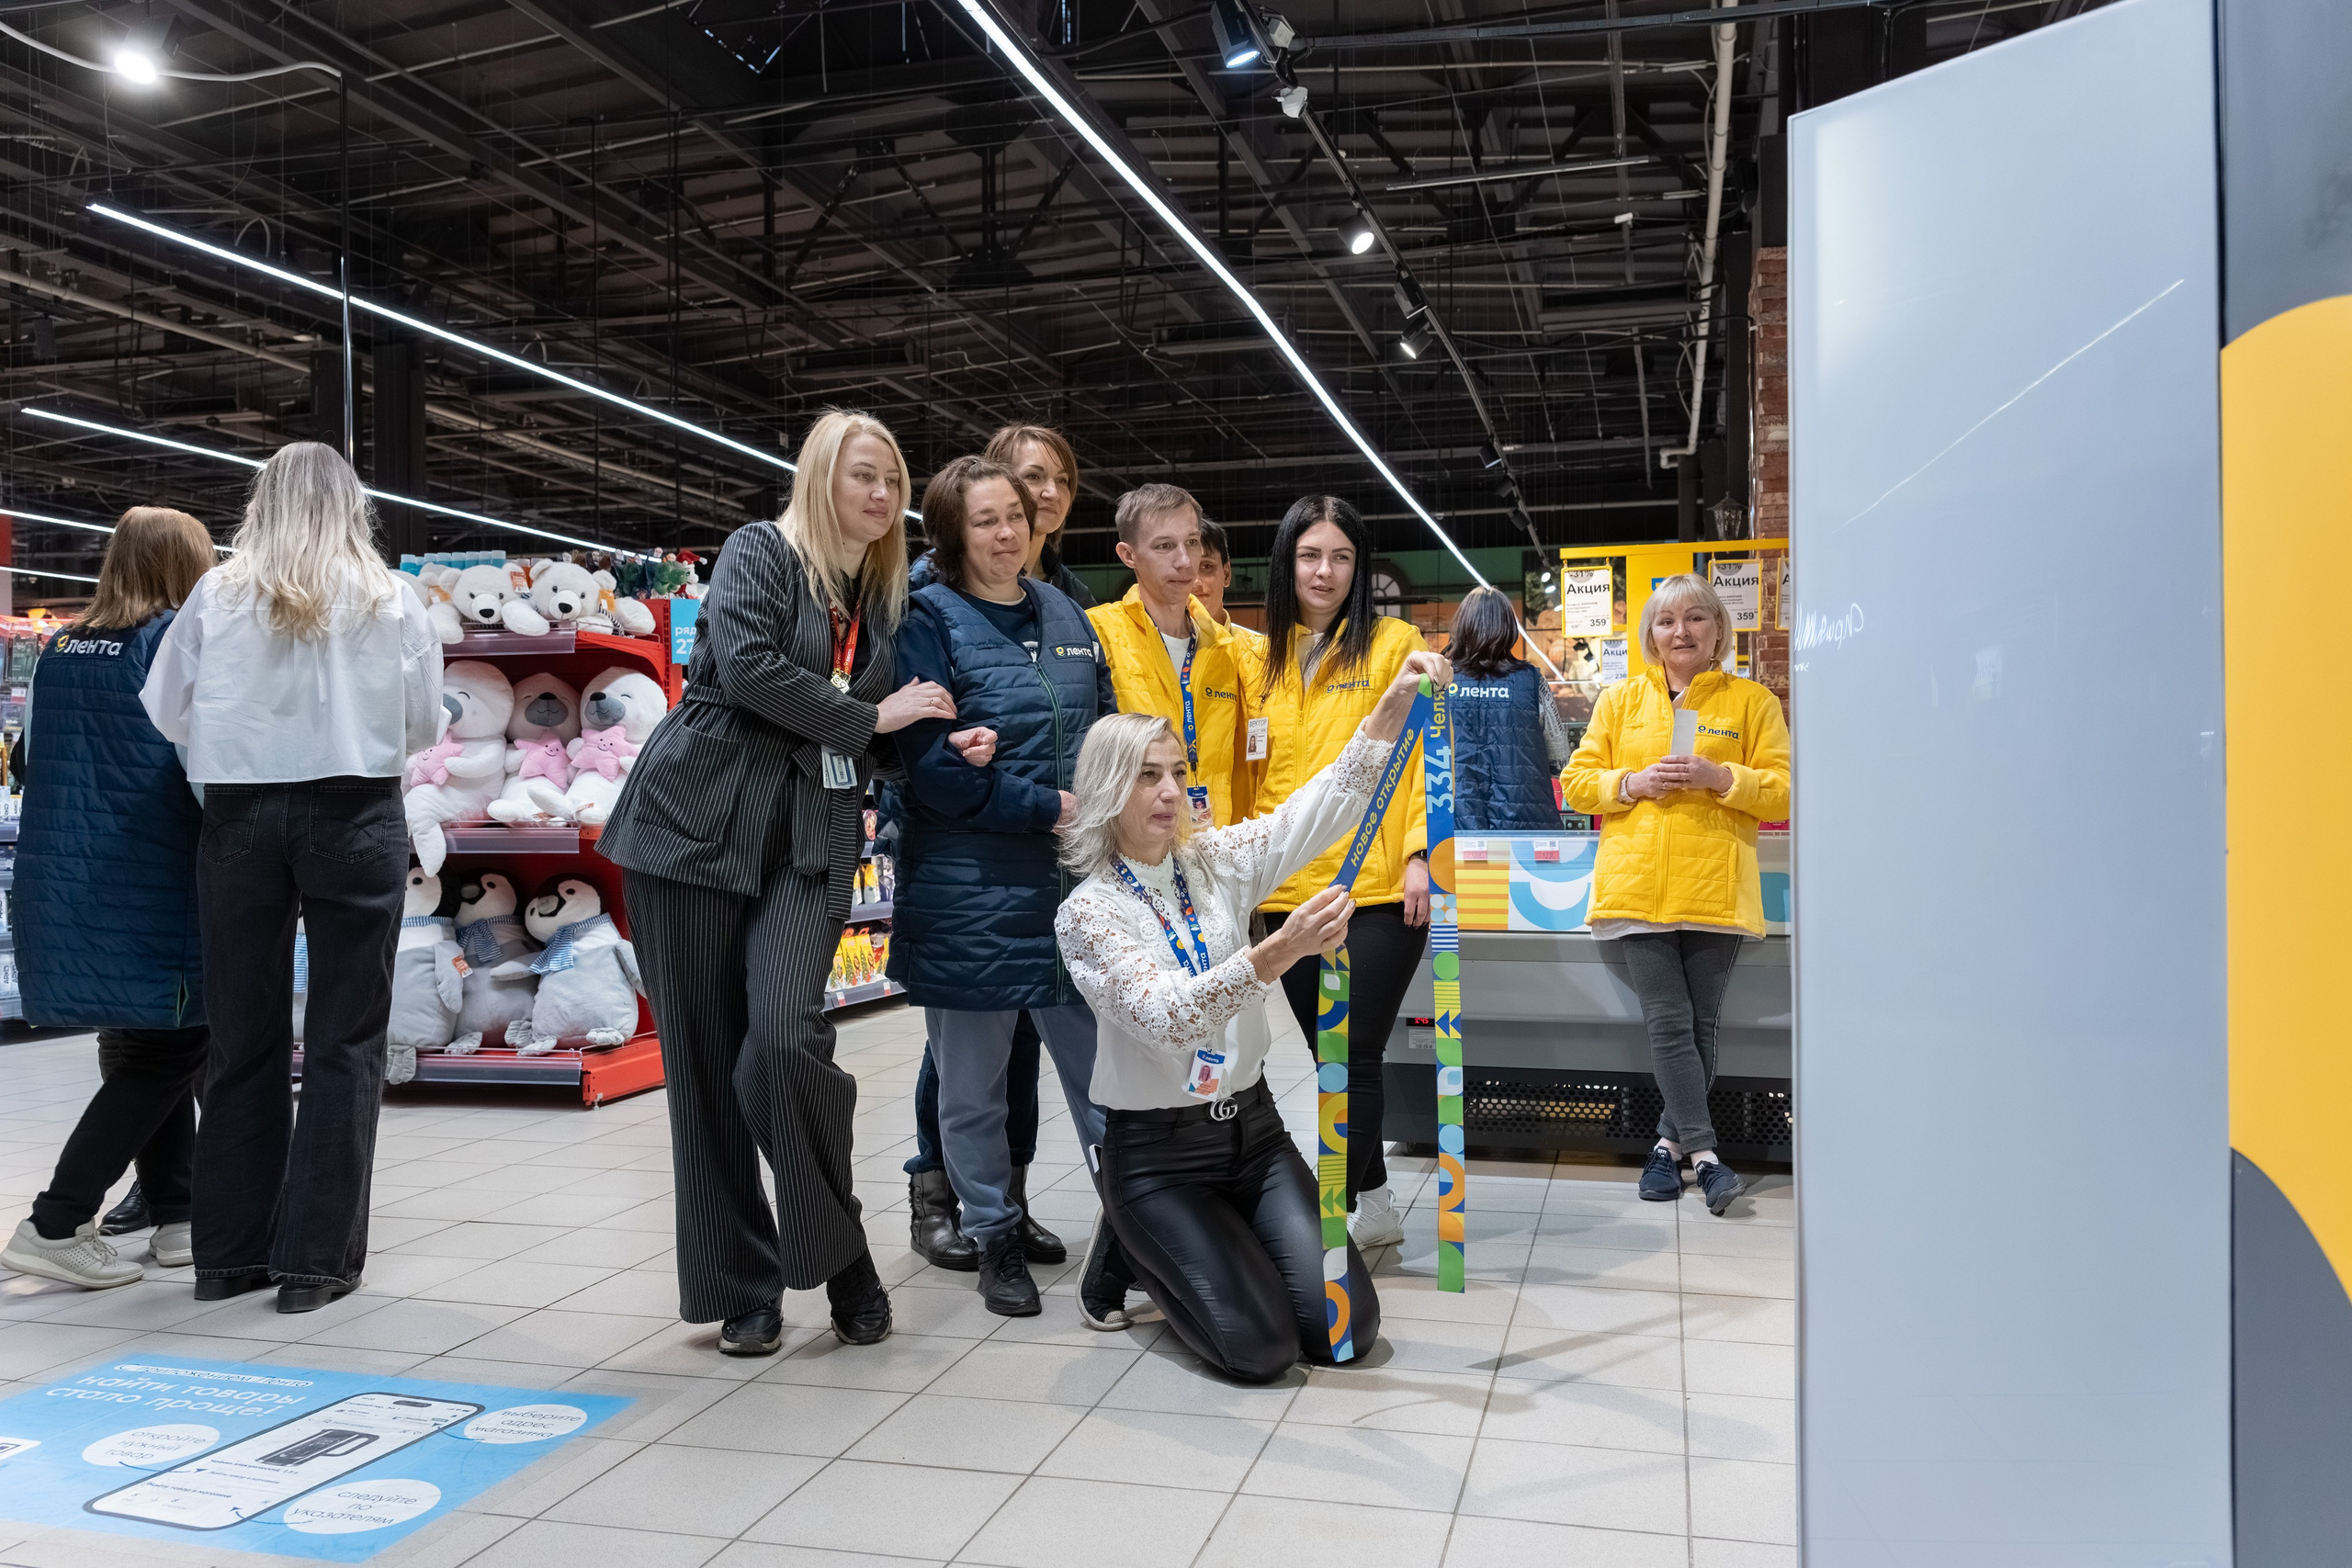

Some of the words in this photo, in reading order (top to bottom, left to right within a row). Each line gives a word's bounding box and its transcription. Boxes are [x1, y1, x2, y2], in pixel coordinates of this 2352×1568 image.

[1713, 575, 1758, 588] Акция
[1566, 583, 1610, 595] Акция
[1589, 618, 1607, 627] 359
[1736, 612, 1754, 621] 359
[674, 626, 697, 637] ряд
[64, 638, 123, 656] лента
[1066, 647, 1093, 658] лента
[1603, 648, 1627, 657] Акци
[1335, 680, 1370, 691] лента
[1459, 685, 1510, 698] лента
[1214, 691, 1237, 701] лент
[1184, 700, 1193, 723] лента
[1707, 728, 1739, 739] лента
[75, 1375, 179, 1393] найти
[180, 1385, 306, 1405] товары
[46, 1387, 142, 1404] стало
[143, 1396, 284, 1417] проще!
[501, 1409, 582, 1422] выберите
[500, 1419, 555, 1430] адрес
[131, 1430, 207, 1444] откройте
[470, 1426, 554, 1438] магазина
[118, 1439, 182, 1451] нужный
[106, 1449, 154, 1460] товар
[337, 1490, 417, 1506] следуйте
[352, 1502, 373, 1512] по
[291, 1507, 395, 1526] указателям
